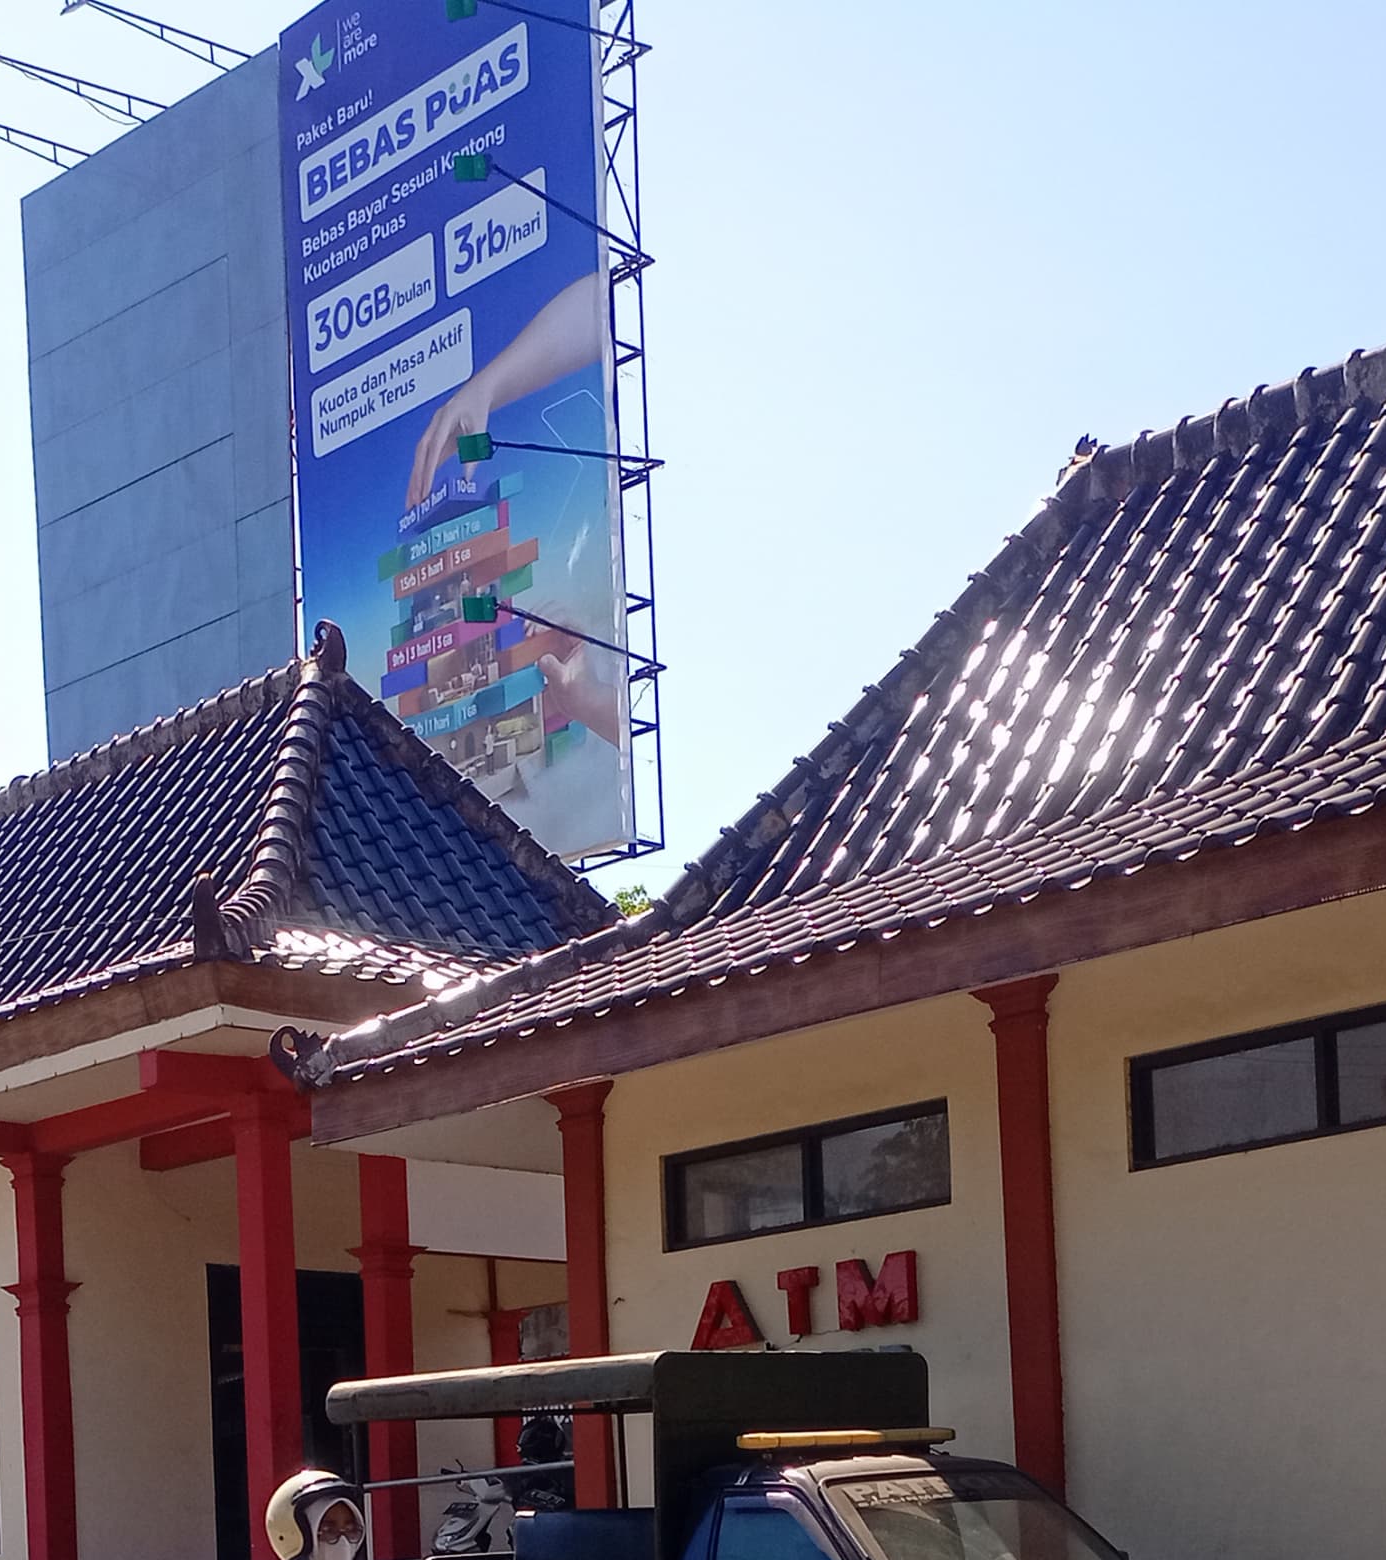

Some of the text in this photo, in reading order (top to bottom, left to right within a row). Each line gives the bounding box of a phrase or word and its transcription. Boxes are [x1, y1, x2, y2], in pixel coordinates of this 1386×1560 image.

[343, 11, 361, 33] we
[343, 27, 362, 49] are
[344, 33, 377, 65] more
[296, 88, 373, 151] Paket Baru!
[306, 42, 521, 206] BEBAS PUAS
[302, 220, 345, 257] Bebas
[347, 195, 388, 230] Bayar
[391, 160, 439, 204] Sesuai
[303, 212, 407, 285] Kuotanya Puas
[453, 212, 541, 275] 3rb/hari
[314, 278, 432, 352] 30GB/bulan
[319, 323, 464, 418] Kuota dan Masa Aktif
[319, 379, 416, 440] Numpuk Terus
[690, 1249, 919, 1351] ATM
